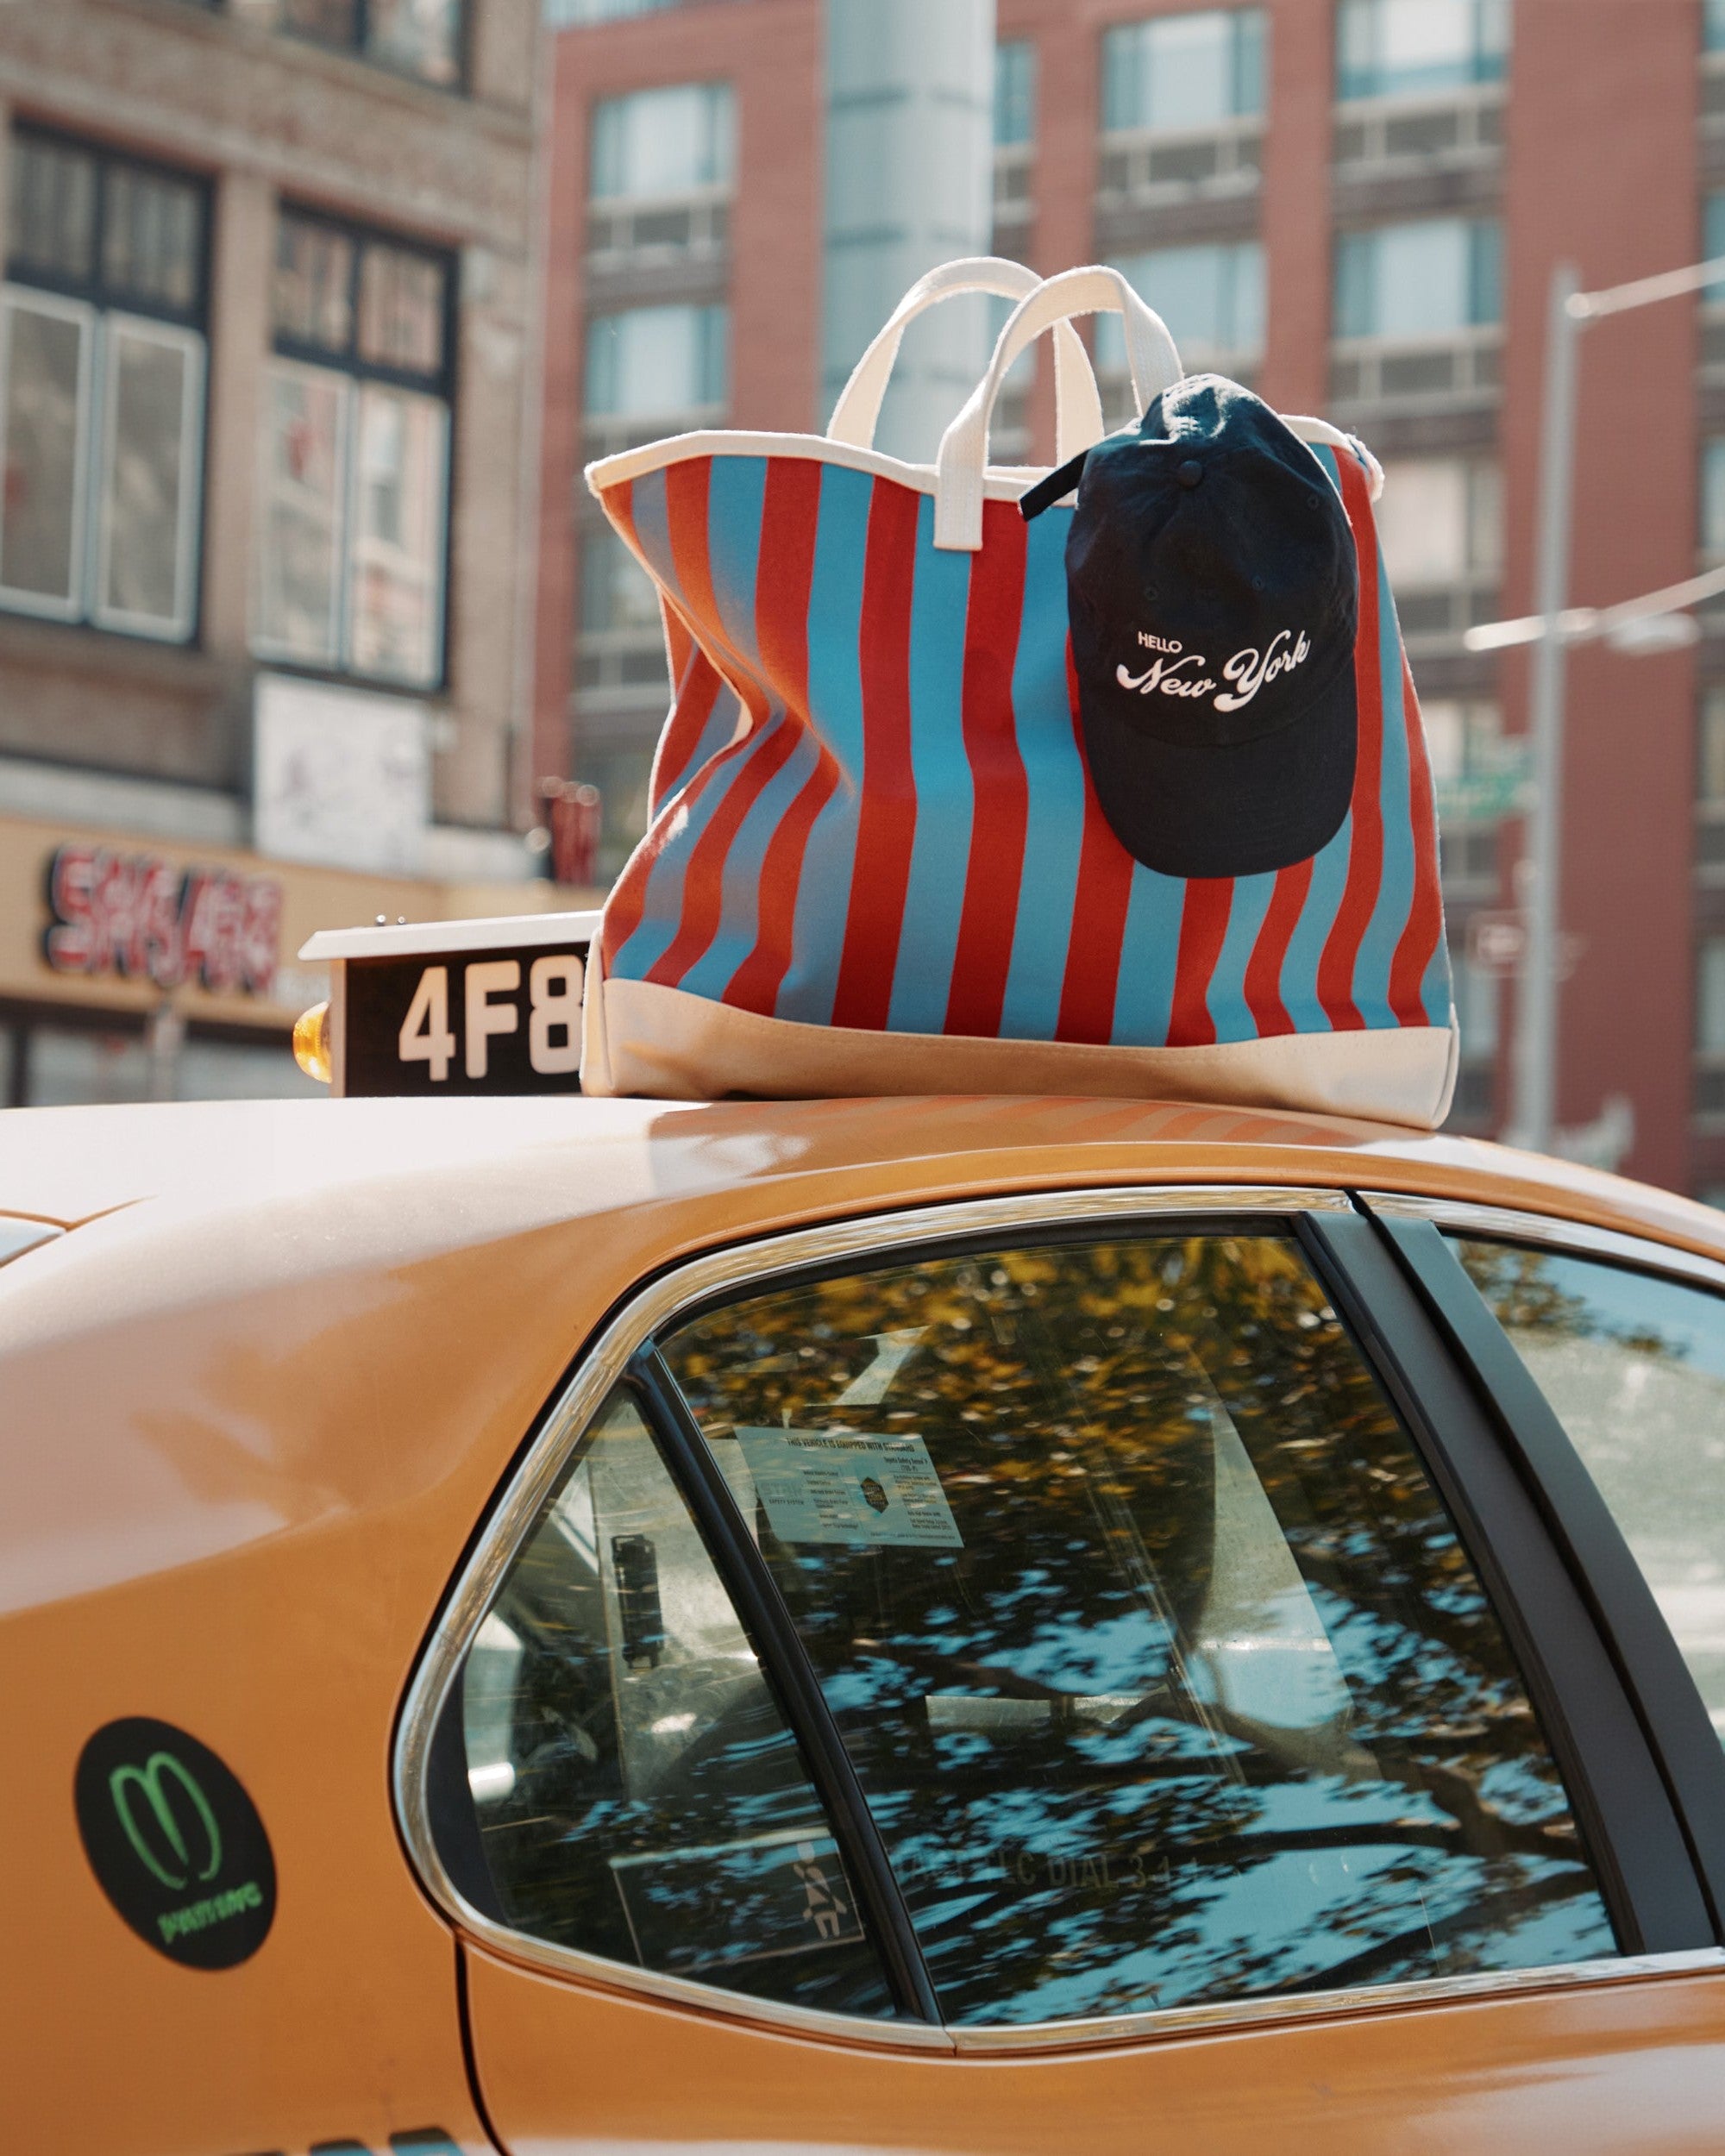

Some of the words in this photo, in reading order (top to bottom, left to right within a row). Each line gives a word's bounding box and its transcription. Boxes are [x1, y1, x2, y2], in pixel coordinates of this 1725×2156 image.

[1138, 630, 1183, 654] HELLO
[1116, 655, 1217, 698] New
[1214, 629, 1312, 712] York
[398, 954, 584, 1082] 4F8
[866, 1441, 883, 1451] WITH
[1047, 1853, 1120, 1889] DIAL
